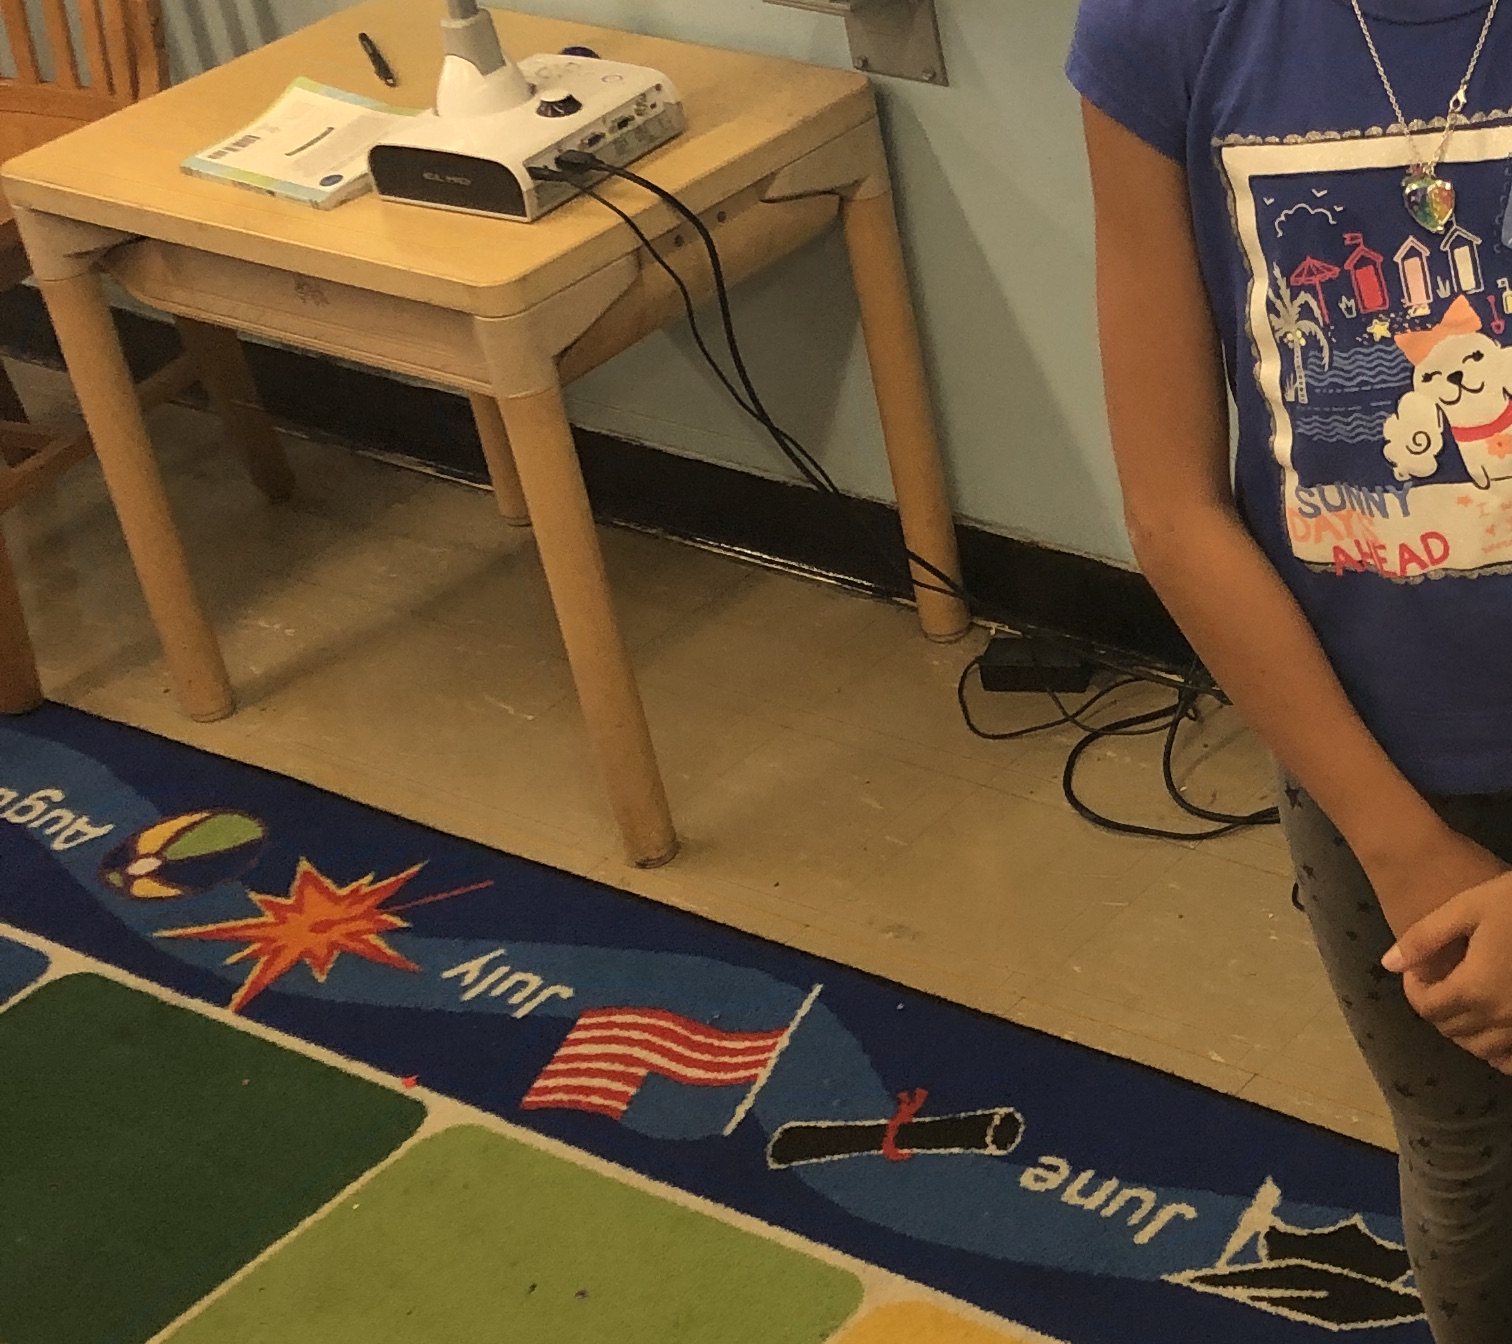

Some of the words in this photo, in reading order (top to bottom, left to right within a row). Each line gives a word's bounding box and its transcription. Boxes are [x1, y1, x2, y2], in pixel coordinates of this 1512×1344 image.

[1293, 481, 1415, 520] SUNNY
[1286, 506, 1378, 545] DAYS
[1331, 530, 1451, 578] AHEAD
[441, 948, 576, 1019] July
[1018, 1154, 1199, 1246] June
